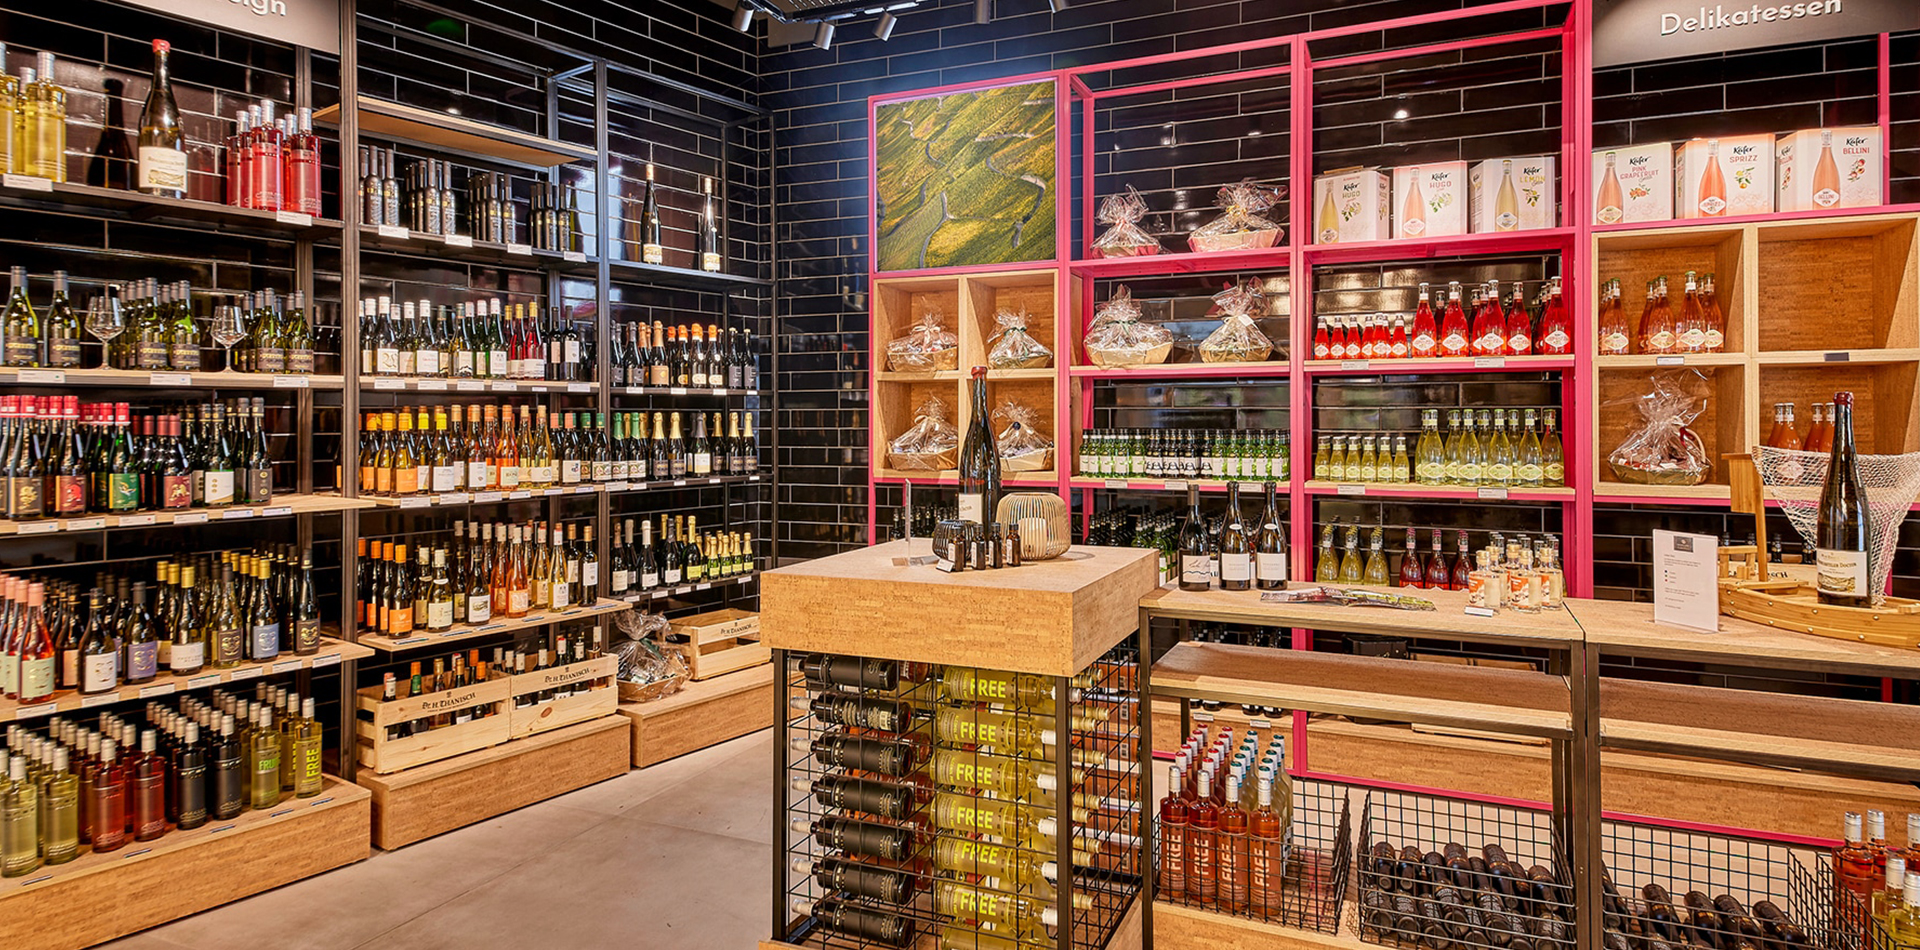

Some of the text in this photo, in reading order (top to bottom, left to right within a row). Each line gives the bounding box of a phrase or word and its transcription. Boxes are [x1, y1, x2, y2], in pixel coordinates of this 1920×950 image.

[1660, 0, 1842, 36] Delikatessen
[1729, 154, 1758, 164] SPRIZZ
[1733, 145, 1756, 155] Käfer
[1843, 147, 1870, 155] BELLINI
[1629, 156, 1651, 166] Käfer
[1429, 180, 1452, 189] HUGO
[1520, 175, 1545, 183] LEMON
[970, 678, 1007, 698] FREE
[960, 721, 996, 742] FREE
[306, 748, 319, 777] FREE
[956, 763, 993, 785] FREE
[957, 806, 993, 829] FREE
[961, 841, 1000, 865] FREE
[960, 892, 998, 916] FREE
